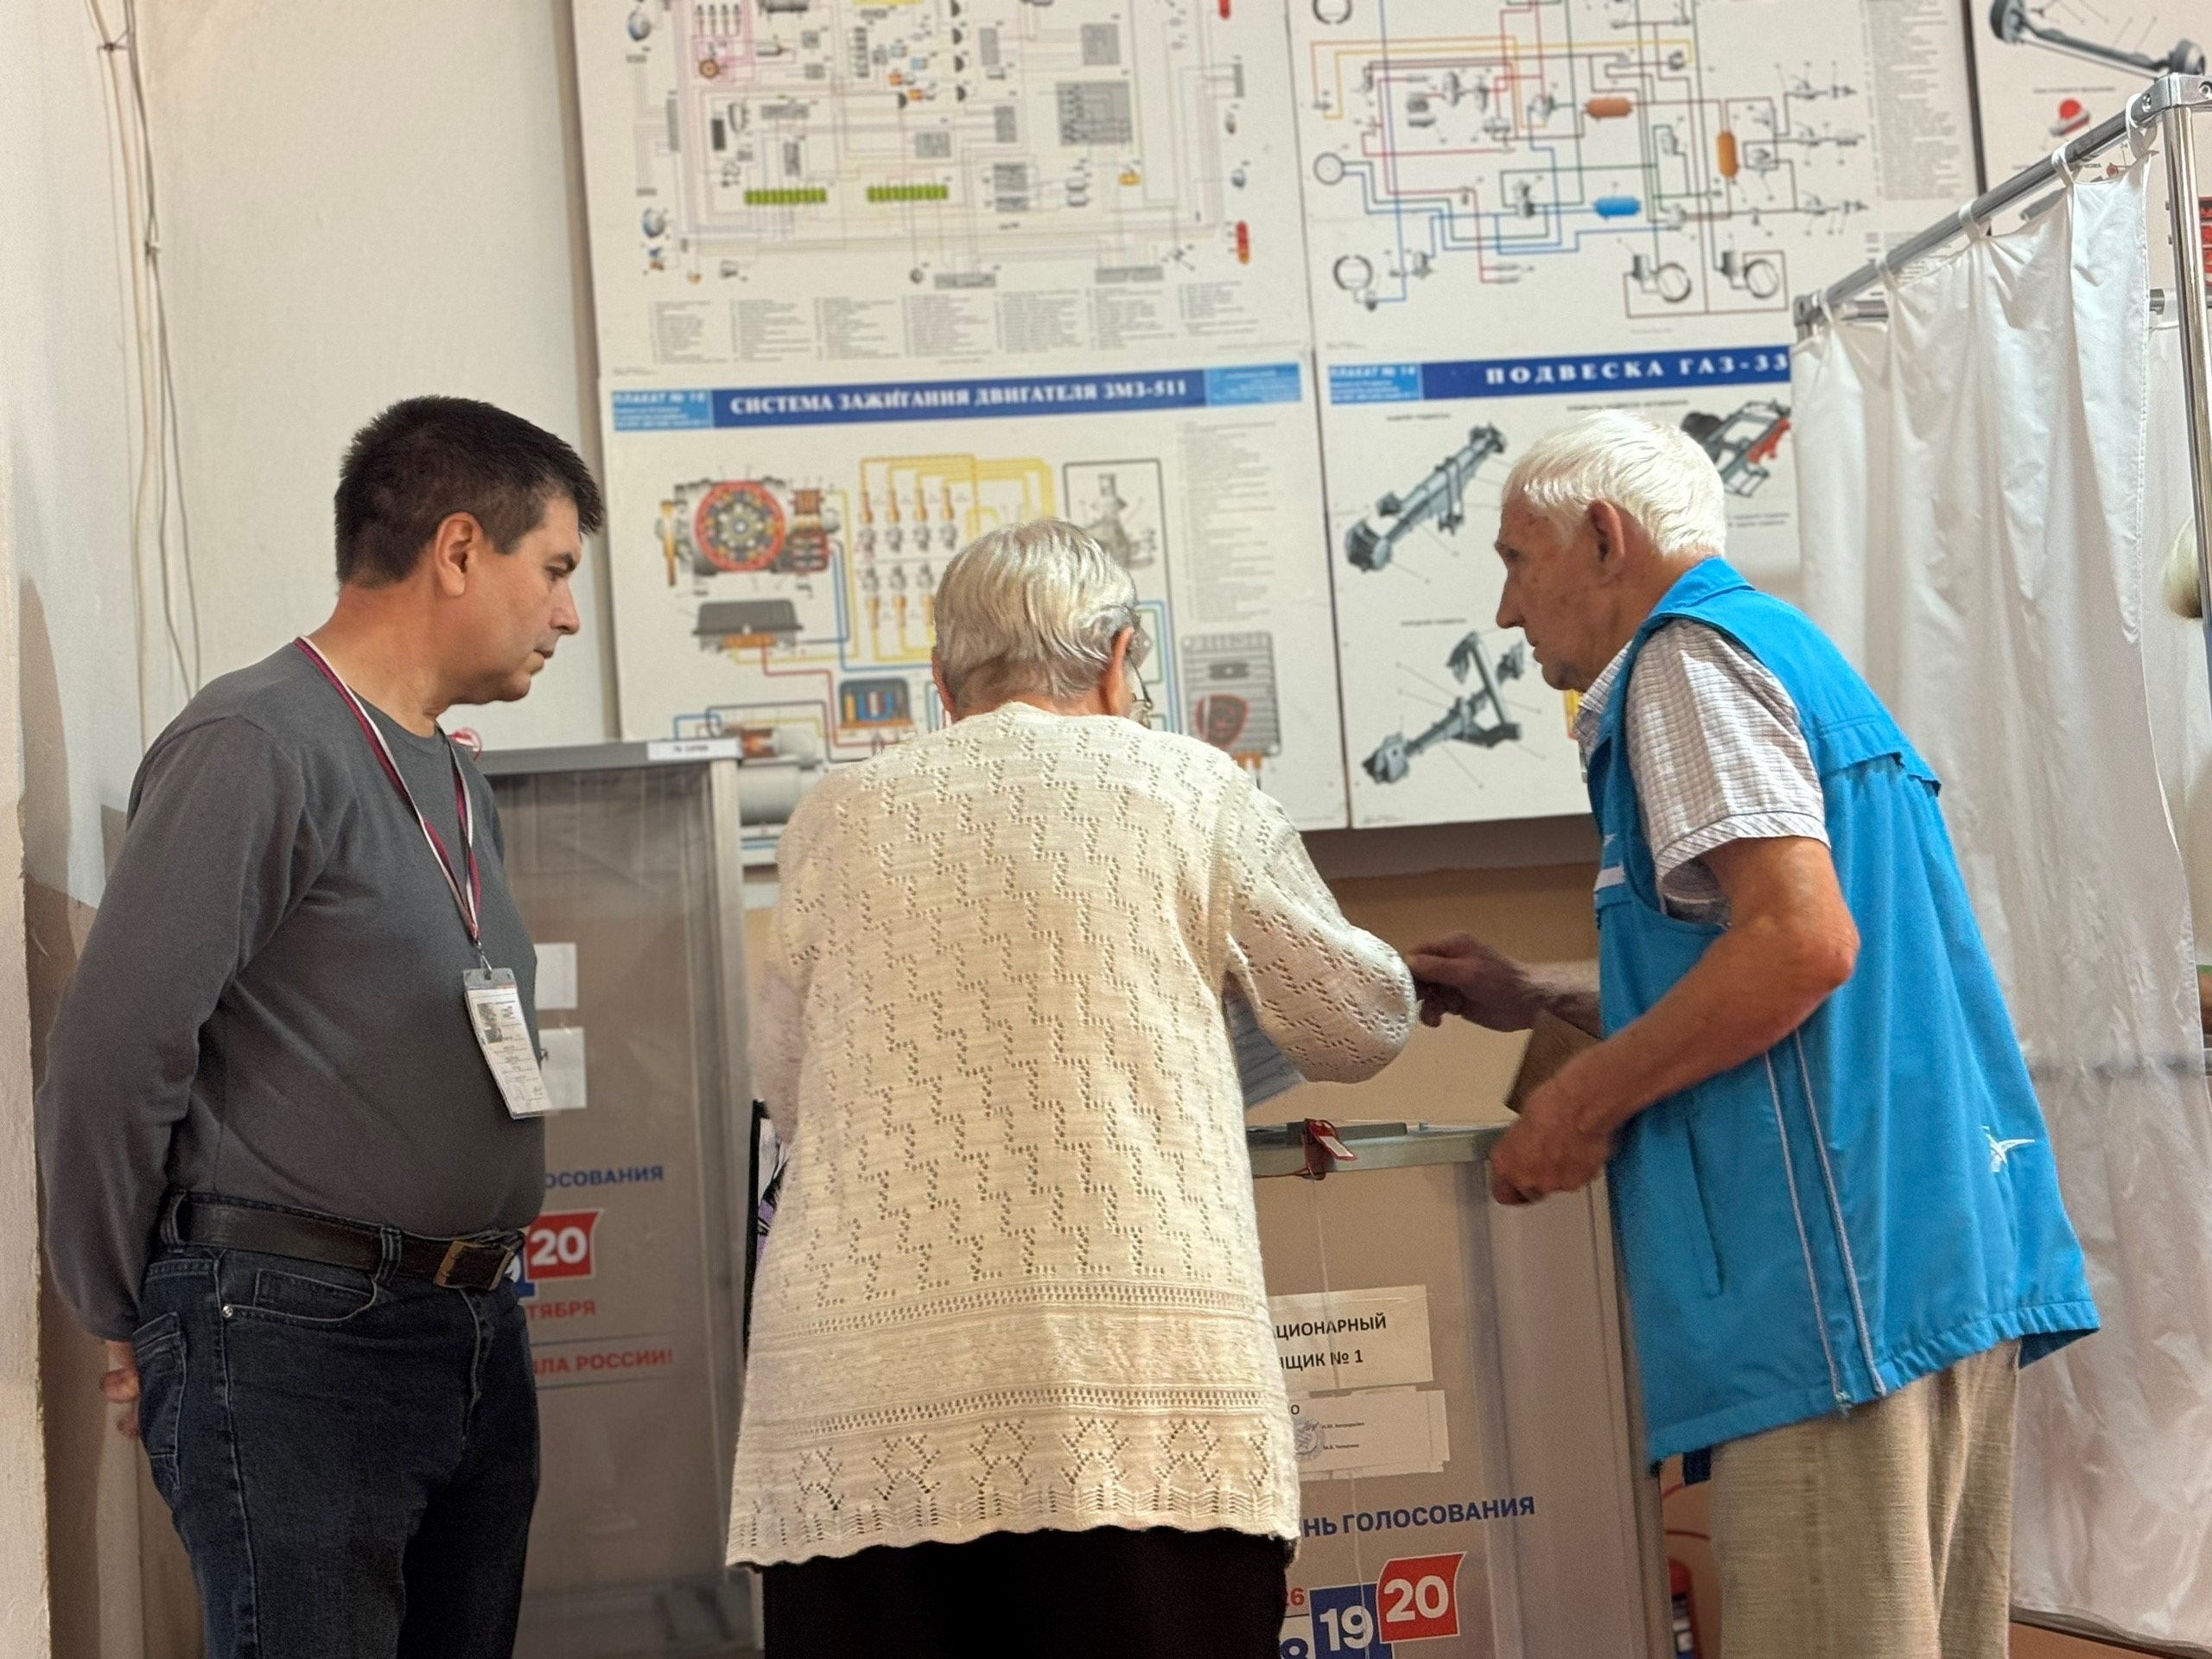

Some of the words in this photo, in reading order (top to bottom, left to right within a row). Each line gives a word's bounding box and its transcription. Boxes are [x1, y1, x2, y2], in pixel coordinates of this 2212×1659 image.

[1485, 360, 1664, 385] ПОДВЕСКА
[1679, 353, 1789, 375] ГАЗ-33
[730, 394, 834, 415] СИСТЕМА
[837, 387, 969, 411] ЗАЖИГАНИЯ
[974, 384, 1097, 407] ДВИГАТЕЛЯ
[1103, 379, 1187, 400] ЗМЗ-511
[531, 1226, 588, 1267] 20
[1274, 1312, 1387, 1341] ЦИОНАРНЫЙ
[575, 1349, 672, 1372] РОССИИ!
[1331, 1351, 1350, 1364] №
[1354, 1349, 1364, 1363] 1
[1342, 1496, 1535, 1534] ГОЛОСОВАНИЯ
[1382, 1574, 1450, 1623] 20
[1319, 1605, 1375, 1651] 19
